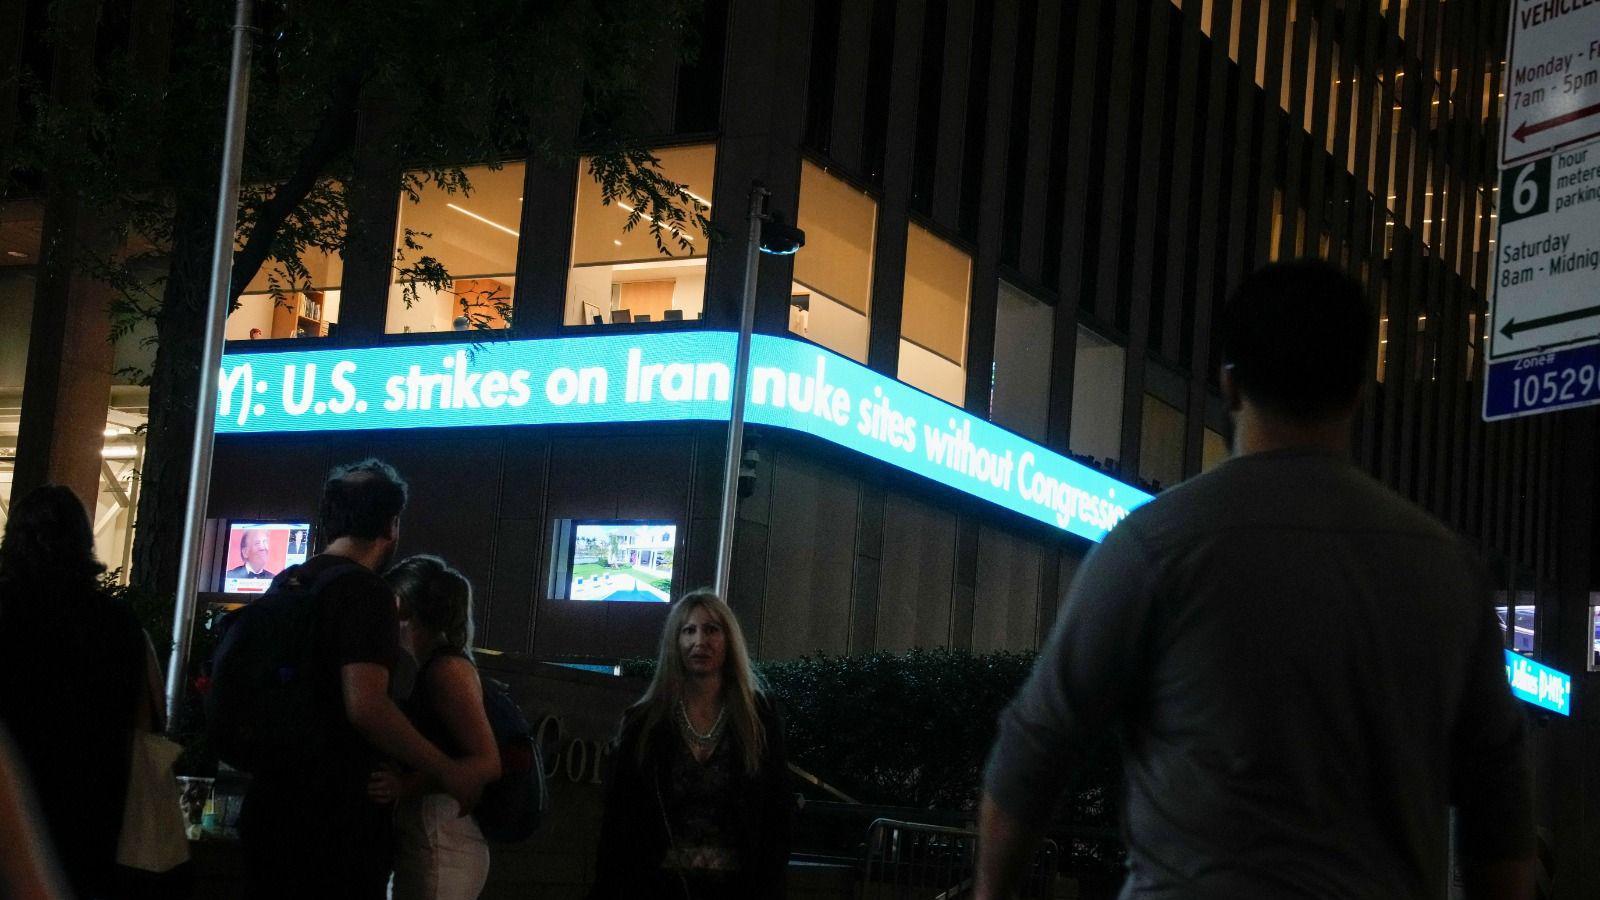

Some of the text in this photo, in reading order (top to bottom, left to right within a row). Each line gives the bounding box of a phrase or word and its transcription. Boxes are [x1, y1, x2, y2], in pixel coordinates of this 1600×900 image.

[1521, 0, 1600, 29] VEHICL
[1514, 53, 1574, 86] Monday
[1513, 88, 1545, 110] 7am
[1563, 69, 1598, 95] 5pm
[1558, 150, 1588, 169] hour
[1512, 162, 1539, 214] 6
[1503, 233, 1570, 264] Saturday
[1501, 266, 1533, 288] 8am
[1513, 353, 1557, 371] Zone#
[282, 360, 368, 416] U.S.
[383, 349, 531, 412] strikes
[544, 366, 609, 406] on
[624, 346, 730, 404] Iran
[752, 355, 849, 427] nuke
[857, 386, 916, 453] sites
[924, 418, 1014, 491] without
[1017, 451, 1130, 532] Congressio
